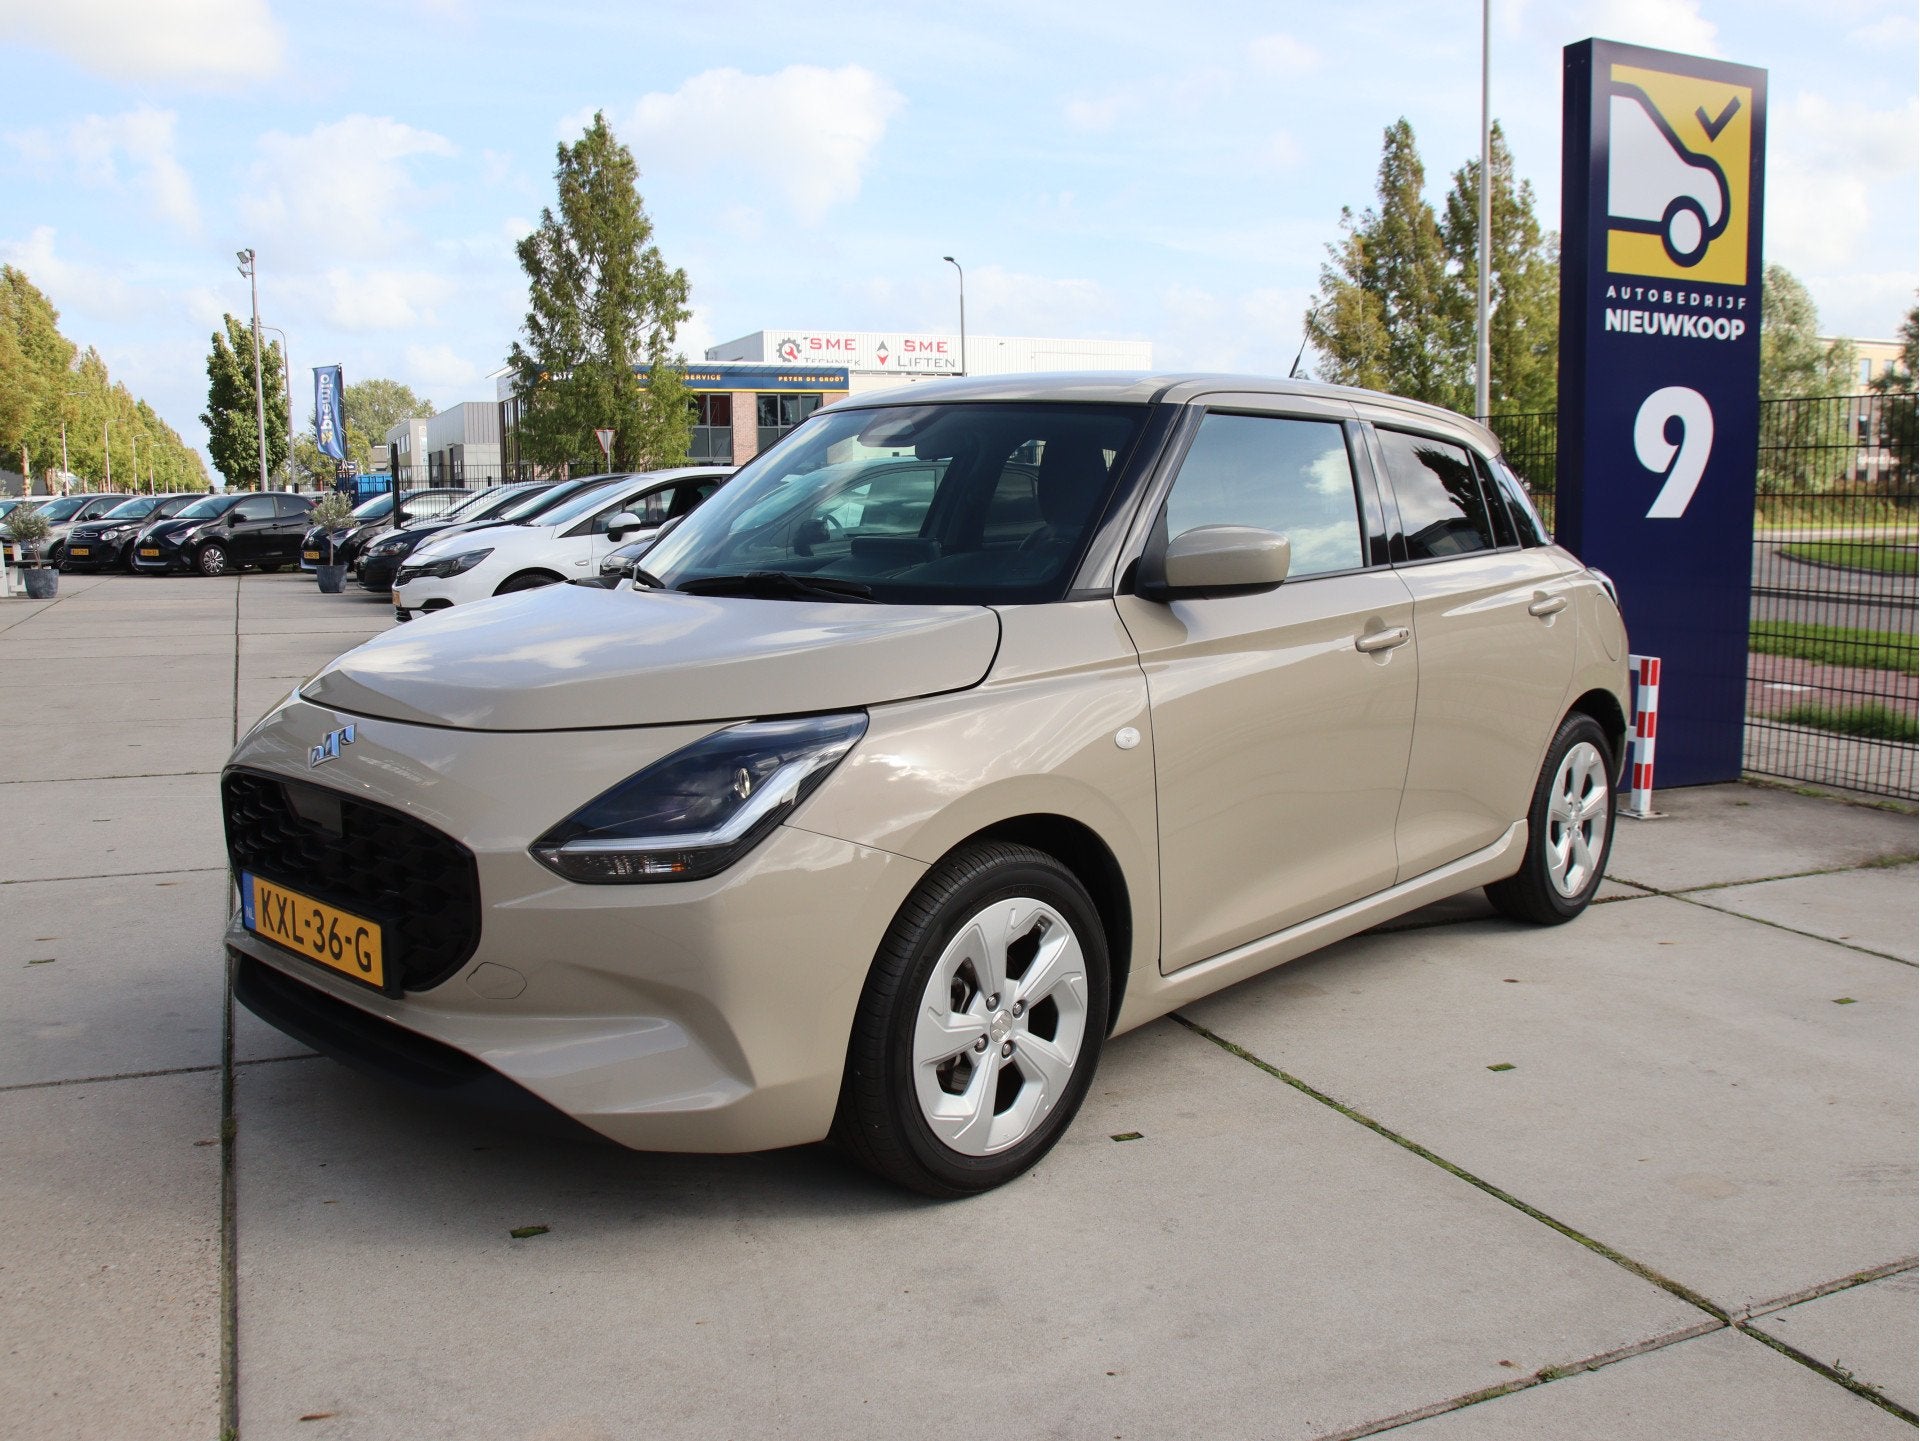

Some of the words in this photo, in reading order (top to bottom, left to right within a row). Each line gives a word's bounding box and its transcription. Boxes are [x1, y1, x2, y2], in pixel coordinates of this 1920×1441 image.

[1606, 285, 1746, 310] AUTOBEDRIJF
[1605, 308, 1746, 341] NIEUWKOOP
[809, 337, 856, 351] SME
[903, 339, 948, 353] SME
[897, 355, 955, 368] LIFTEN
[1633, 386, 1714, 519] 9
[261, 887, 372, 973] KXL-36-G
